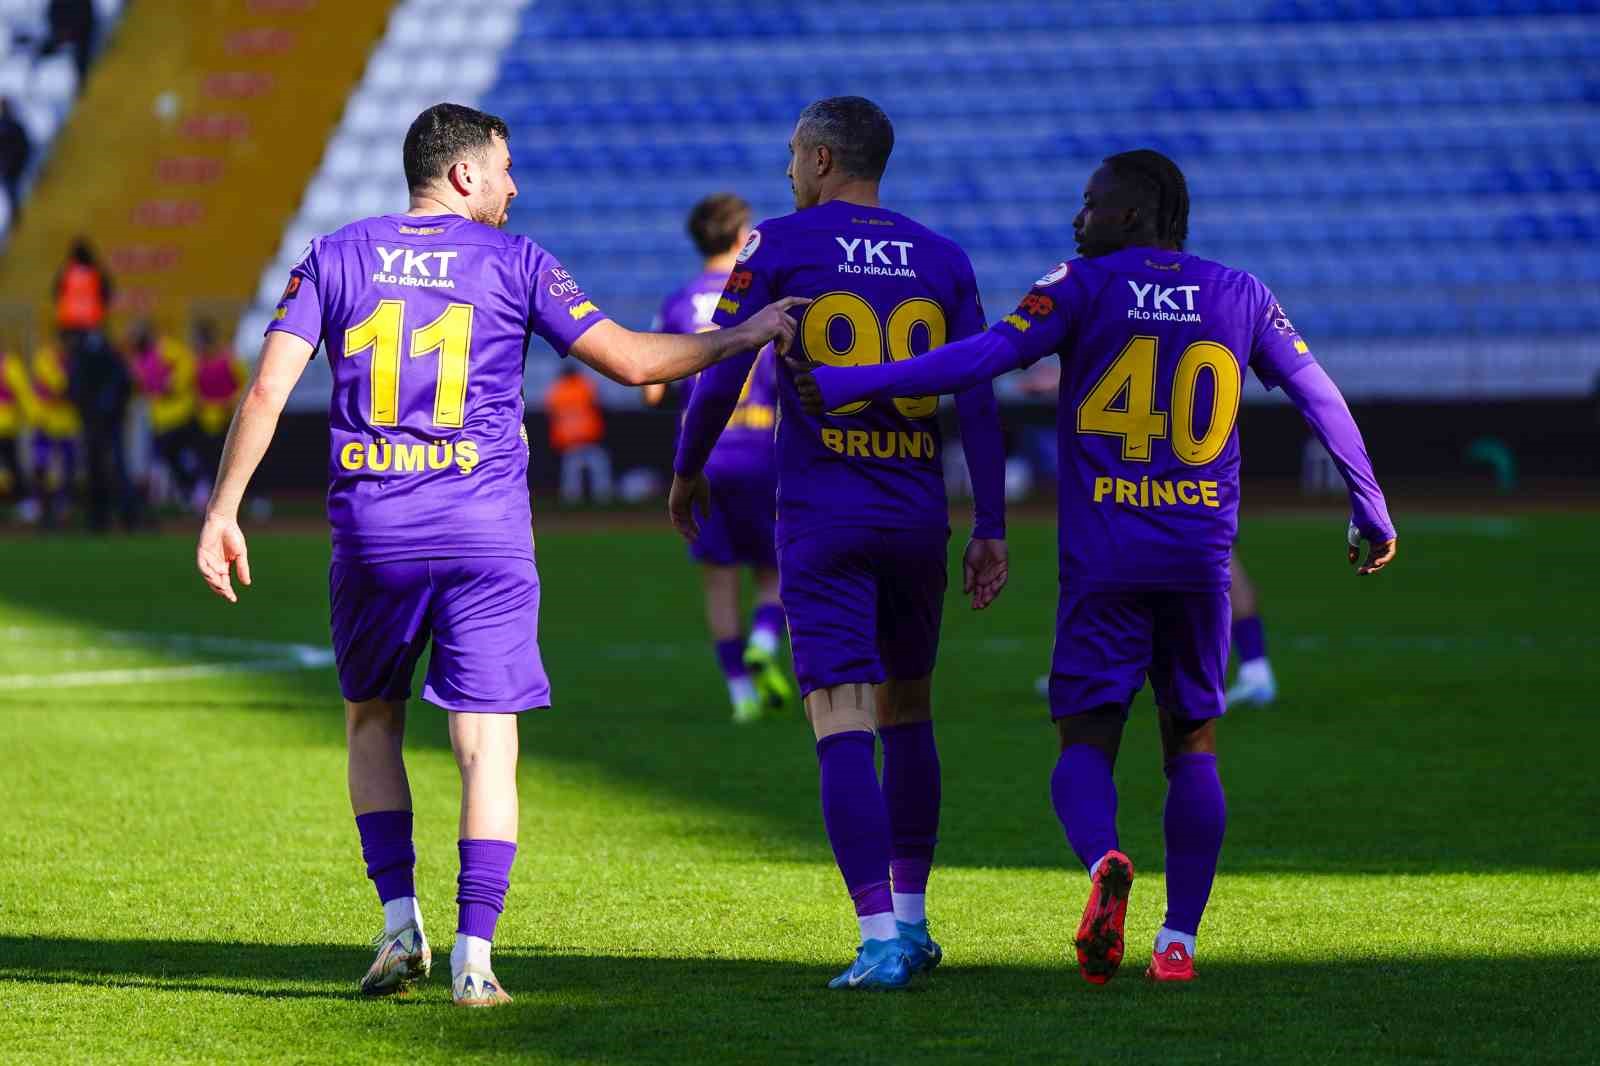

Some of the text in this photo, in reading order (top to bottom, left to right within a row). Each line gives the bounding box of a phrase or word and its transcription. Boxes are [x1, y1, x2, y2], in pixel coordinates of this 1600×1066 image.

[375, 246, 458, 278] YKT
[835, 236, 914, 266] YKT
[372, 271, 456, 289] FİLO KİRALAMA
[837, 262, 917, 278] FİLO KİRALAMA
[1127, 280, 1200, 311] YKT
[1127, 307, 1202, 323] FİLO KİRALAMA
[344, 299, 474, 428] 11
[1076, 335, 1242, 466] 40
[340, 438, 480, 474] GÜMÜŞ
[821, 427, 935, 459] BRUNO
[1093, 475, 1220, 508] PRİNCE
